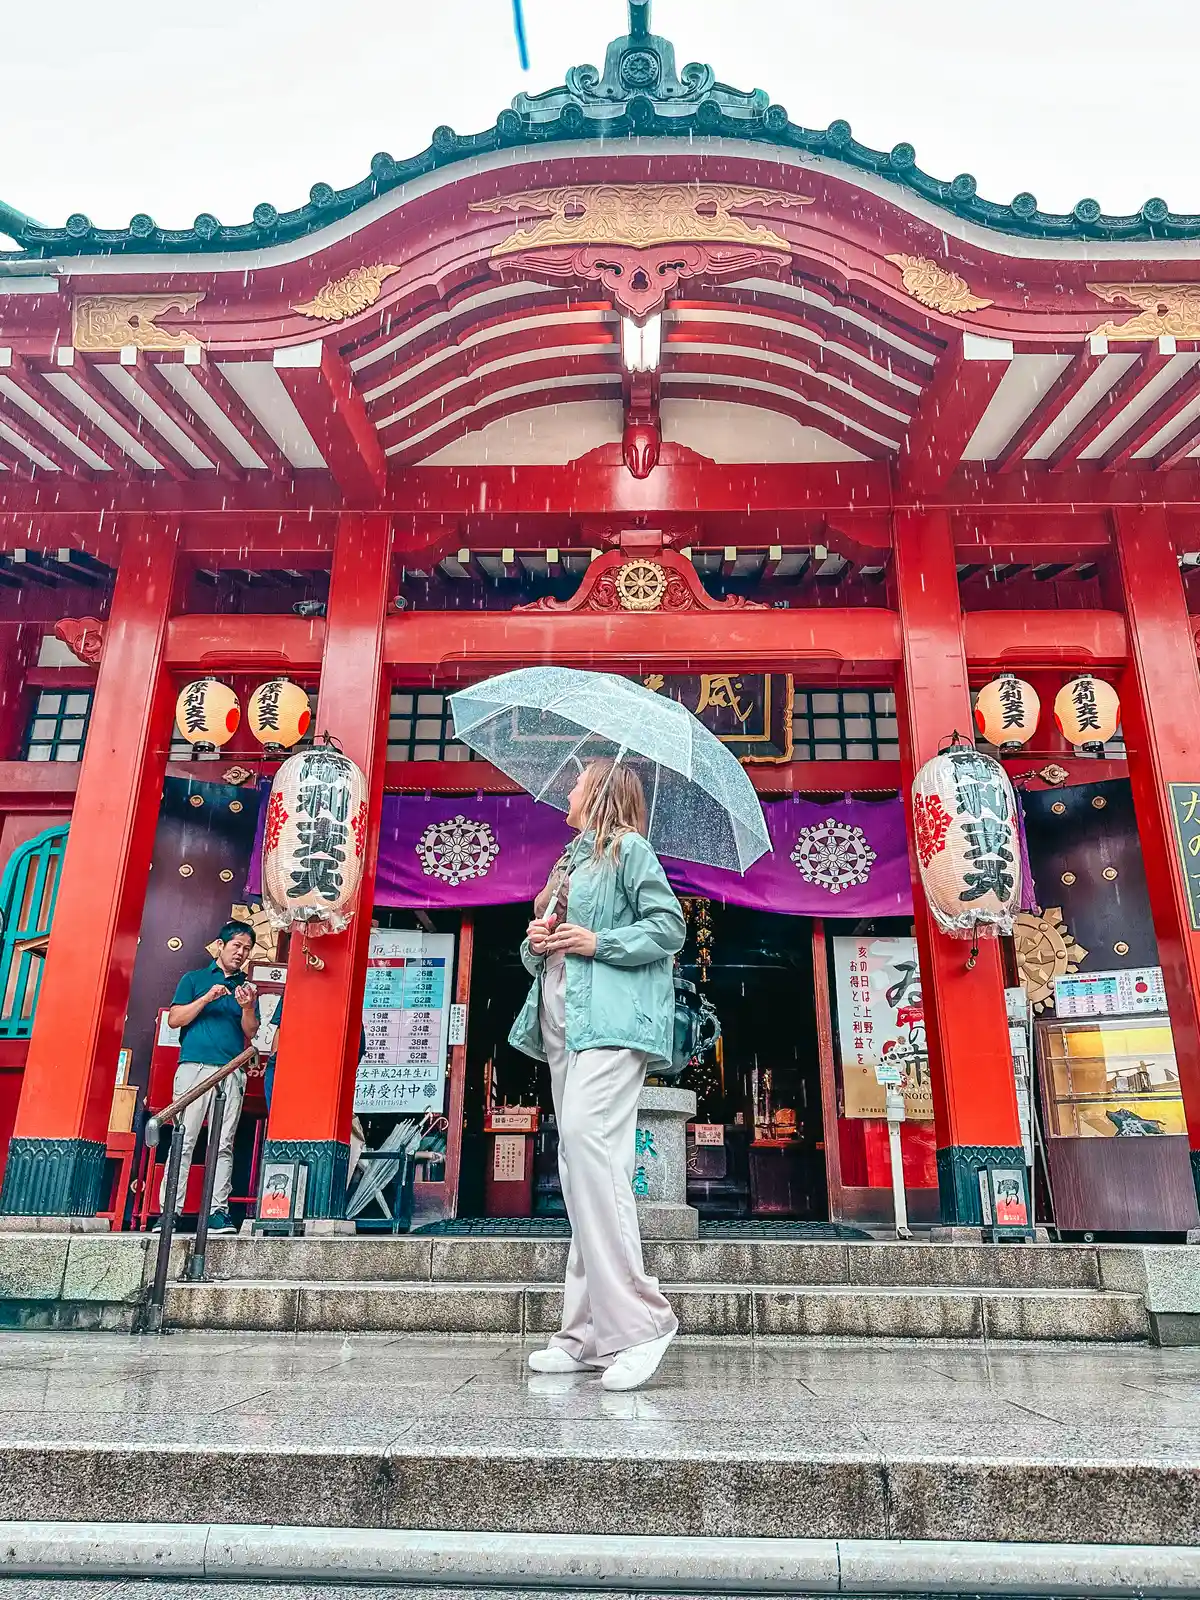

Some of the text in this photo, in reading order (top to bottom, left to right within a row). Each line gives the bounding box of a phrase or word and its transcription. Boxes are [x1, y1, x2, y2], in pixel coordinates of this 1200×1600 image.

[183, 681, 210, 734] 摩利支天
[257, 682, 282, 732] 摩利支天
[998, 679, 1025, 730] 摩利支天
[1072, 680, 1101, 733] 摩利支天
[375, 970, 392, 978] 25歳
[416, 970, 434, 978] 26歳
[415, 983, 432, 991] 43歳
[414, 996, 432, 1004] 62歳
[372, 1012, 389, 1020] 19歳
[849, 961, 868, 1074] お得とご利益を。
[370, 1025, 387, 1033] 33歳
[368, 1039, 386, 1047] 37歳
[411, 1038, 429, 1046] 38歳
